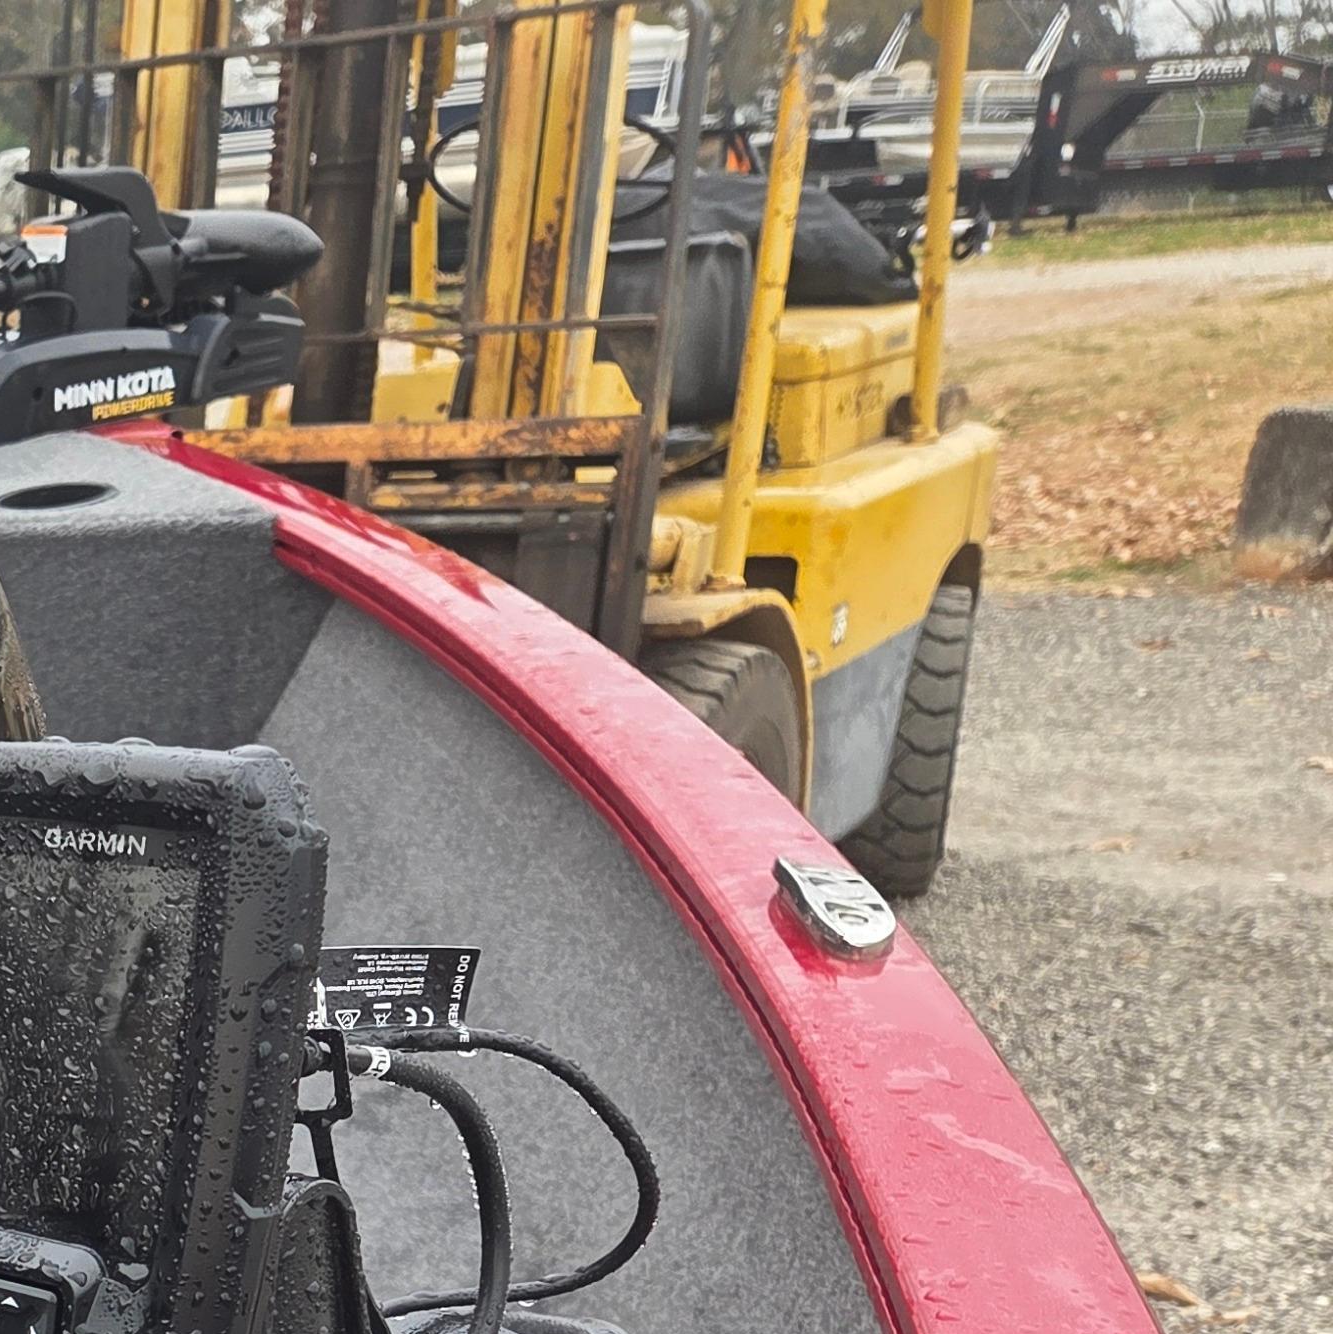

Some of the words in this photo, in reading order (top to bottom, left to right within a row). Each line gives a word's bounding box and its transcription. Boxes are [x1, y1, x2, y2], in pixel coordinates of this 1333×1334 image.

[54, 376, 114, 412] MINN
[117, 365, 175, 399] KOTA
[44, 826, 147, 856] GARMIN
[456, 955, 471, 973] DO
[450, 975, 467, 1000] NOT
